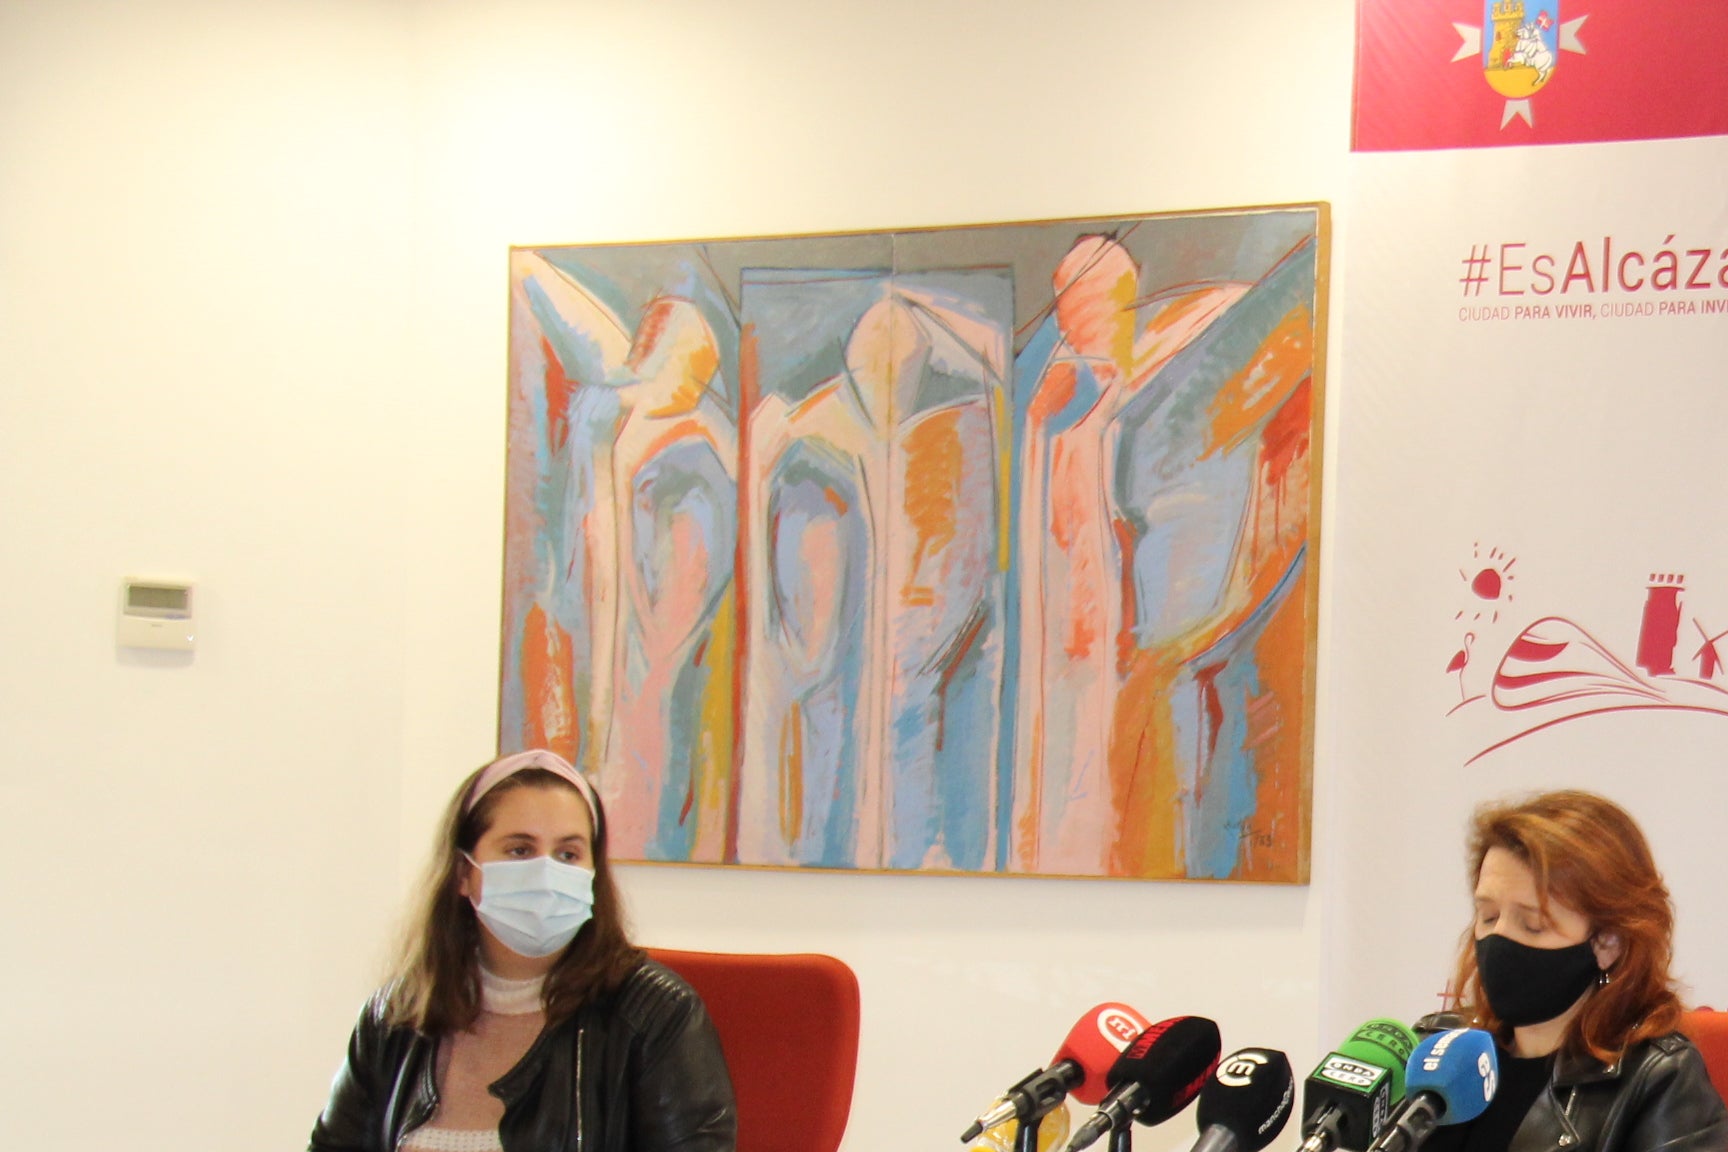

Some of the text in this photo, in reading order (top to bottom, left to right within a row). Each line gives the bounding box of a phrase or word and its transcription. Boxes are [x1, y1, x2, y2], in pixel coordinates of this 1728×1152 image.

[1458, 306, 1510, 321] CIUDAD
[1515, 305, 1550, 320] PARA
[1556, 304, 1597, 320] VIVIR,
[1600, 302, 1654, 318] CIUDAD
[1659, 301, 1696, 315] PARA
[1333, 1063, 1373, 1077] ONDA
[1329, 1071, 1366, 1084] CERO
